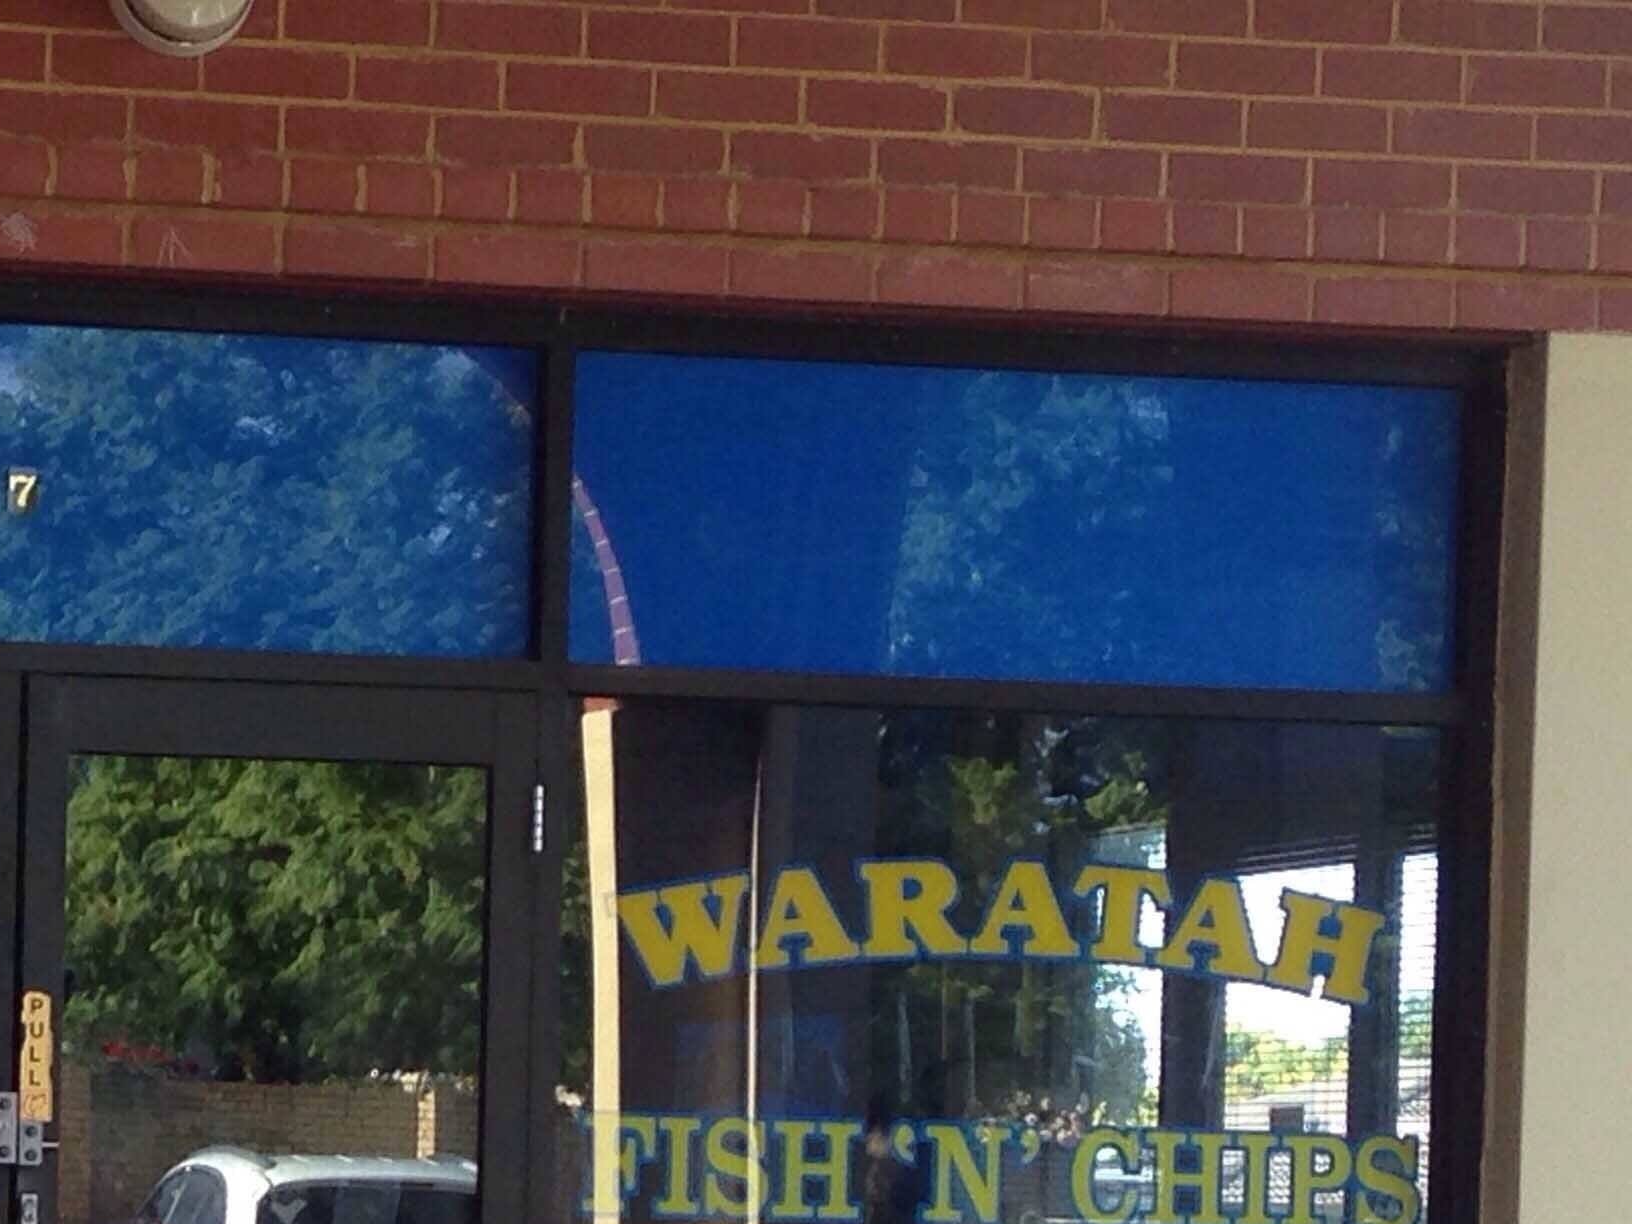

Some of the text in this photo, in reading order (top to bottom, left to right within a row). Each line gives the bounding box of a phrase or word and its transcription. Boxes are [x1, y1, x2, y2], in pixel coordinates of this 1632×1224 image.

[9, 474, 37, 507] 7
[618, 858, 1385, 1002] WARATAH
[28, 997, 45, 1087] PULL
[581, 1112, 866, 1223] FISH
